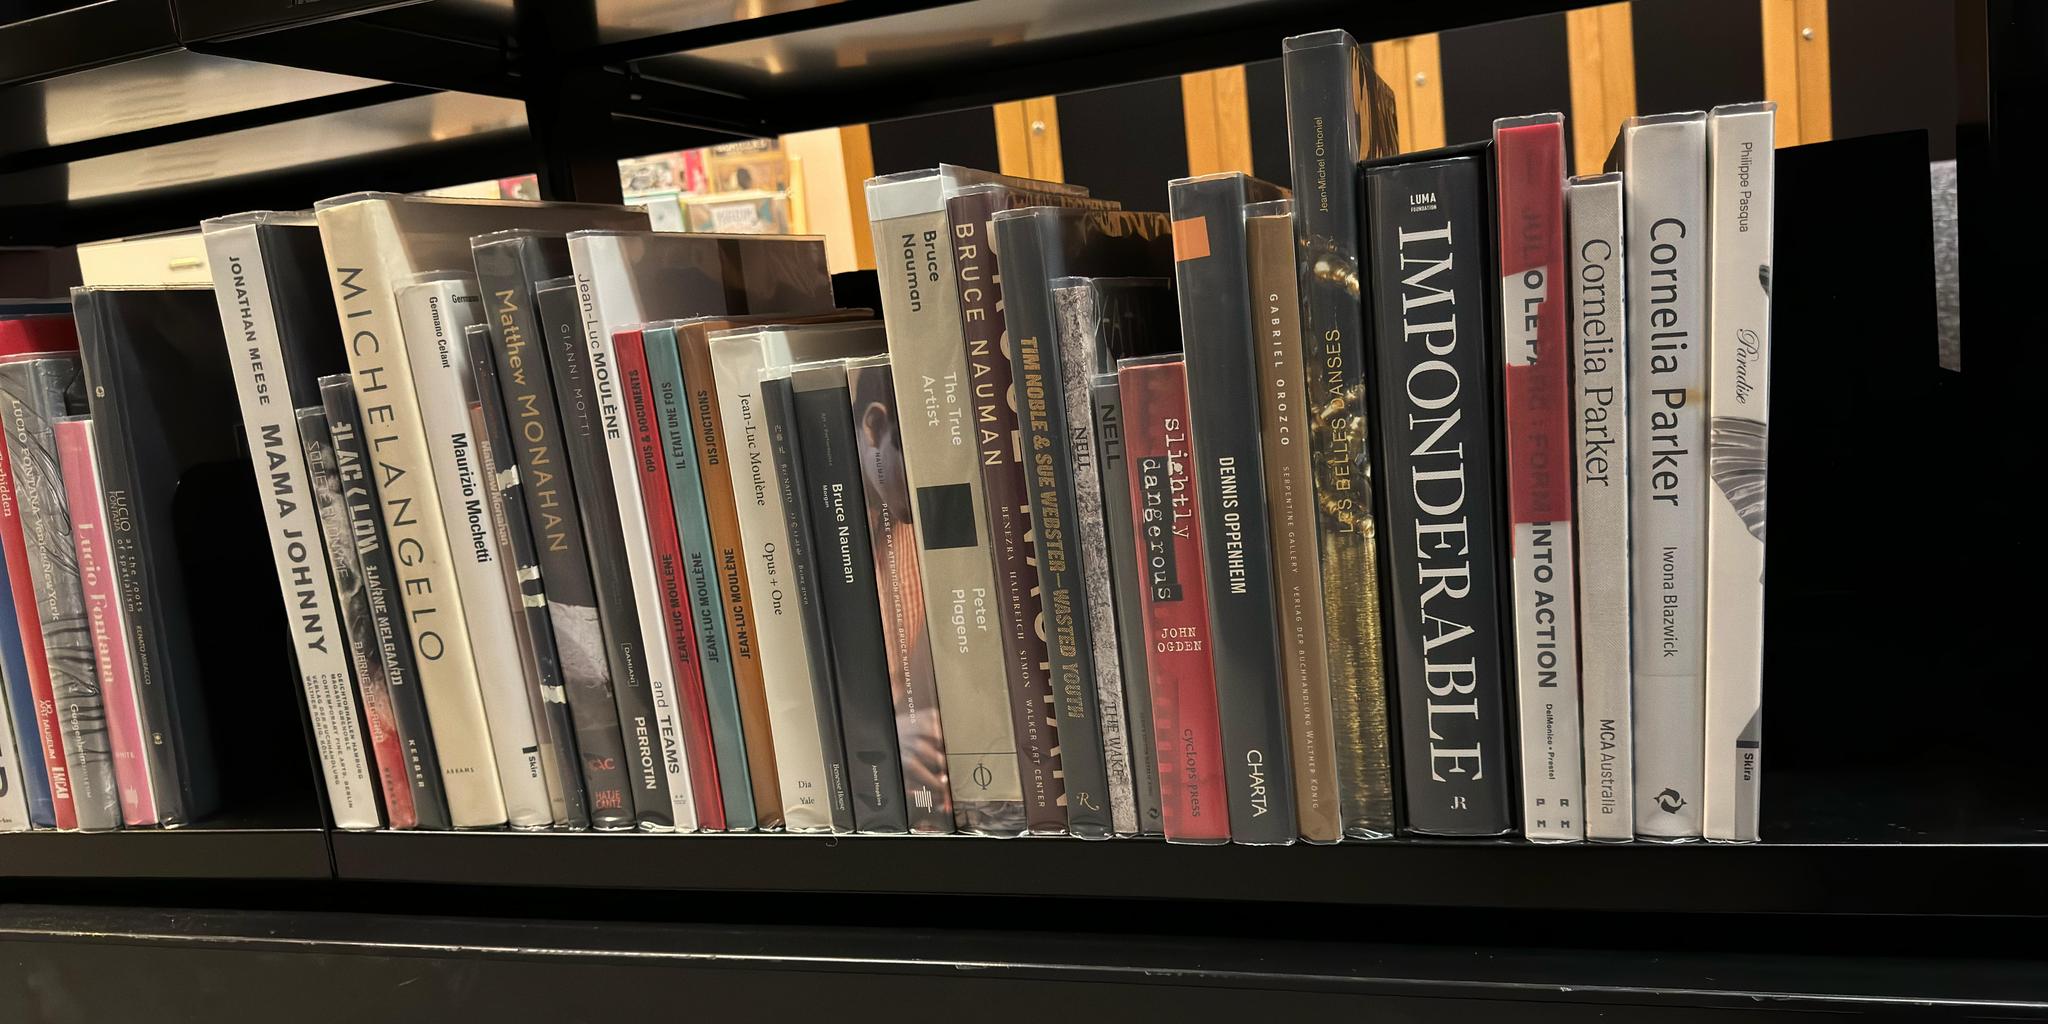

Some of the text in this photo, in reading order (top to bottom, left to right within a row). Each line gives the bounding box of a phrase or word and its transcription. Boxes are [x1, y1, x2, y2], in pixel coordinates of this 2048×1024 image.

[1311, 116, 1330, 212] Jean-Michel Othoniel
[1409, 191, 1436, 205] LUMA
[1736, 141, 1753, 232] Philippe Pasqua
[1410, 202, 1437, 213] FOUNDATION
[901, 233, 922, 312] Nauman
[923, 230, 940, 281] Bruce
[952, 223, 988, 322] BRUCE
[228, 256, 271, 405] JONATHAN MEESE
[425, 297, 453, 368] Germano Celant
[576, 273, 624, 438] Jean-Luc MOULÈNE
[1019, 336, 1041, 371] TIM
[1575, 238, 1621, 487] Cornelia Parker
[1644, 217, 1692, 507] Cornelia Parker
[559, 324, 591, 436] GIANNI MOTTI
[627, 369, 649, 431] DOCUMENTS
[921, 375, 941, 426] Artist
[968, 339, 1004, 465] NAUMAN
[1023, 374, 1049, 431] NOBLE
[1267, 293, 1290, 446] GABRIEL OROZCO
[1731, 328, 1760, 406] Paradise
[492, 289, 569, 551] Matthew MONAHAN
[660, 382, 686, 468] IL UNE FOIS
[697, 390, 719, 464] DISJONCTIONS
[942, 371, 966, 445] The True
[1031, 434, 1051, 450] &
[1100, 404, 1121, 470] NELL
[1324, 328, 1354, 532] LES BELLES DANSES
[11, 400, 41, 514] LUCIO FONTANA
[334, 268, 449, 660] MICHELANGELO
[642, 445, 656, 472] OPUS
[737, 393, 769, 505] Jean-Luc Moulène
[1034, 453, 1056, 488] SUE
[1073, 426, 1091, 471] NELL
[1160, 418, 1196, 539] slightly
[107, 490, 122, 531] FONTANA
[114, 490, 131, 531] LUCIO
[451, 433, 491, 562] Maurizio Mochetti
[480, 441, 510, 544] Matthew Monahan
[783, 477, 792, 502] NAITO
[821, 484, 829, 508] Morgan
[881, 503, 890, 532] PLEASE
[1217, 456, 1247, 594] DENNIS OPPENHEIM
[1281, 466, 1298, 573] SERPENTINE GALLERY
[1398, 220, 1485, 782] IMPONDERABLE
[1524, 298, 1557, 688] LE INTO ACTION
[259, 424, 328, 653] MAMA JOHNNY
[831, 483, 854, 583] Bruce Nauman
[1039, 491, 1067, 572] WEBSTER
[1137, 458, 1174, 600] dangerous
[76, 523, 121, 683] Lucio Fontana
[115, 538, 135, 612] of spatialism
[124, 538, 144, 612] at the roots
[689, 551, 719, 662] JEAN-LUC MOULÈNE
[721, 547, 750, 658] JEAN-LUC MOULÈNE
[760, 542, 779, 575] Opus
[770, 589, 785, 615] One
[887, 550, 898, 592] ATTENTION
[1661, 546, 1680, 657] Iwona Blazwick
[135, 625, 146, 651] RENATO
[671, 610, 690, 663] JEAN-LUC
[898, 628, 907, 653] BRUCE
[948, 589, 970, 653] Plagens
[971, 587, 989, 632] Peter
[1051, 589, 1077, 657] WASTED
[1161, 625, 1196, 640] JOHN
[352, 641, 371, 683] BJARNE
[377, 616, 404, 685] MELGAARD
[901, 656, 913, 694] NAUMAN'S
[1000, 506, 1045, 807] BENEZRA HALBREICH SIMON WALKER ART CENTER
[1157, 638, 1202, 654] OGDEN
[1292, 585, 1317, 775] VERLAG DER BUCHHANDLUNG WALTHER
[329, 673, 351, 751] MAGASIN GRENOBLE
[335, 673, 363, 779] DEICHTORHALLEN HAMBURG
[653, 681, 668, 707] and
[907, 697, 917, 724] WORDS
[1061, 662, 1084, 718] YOUTH
[42, 720, 55, 759] MUSEUM
[67, 703, 88, 764] Guggenheim
[311, 675, 340, 784] VERLAG DER BUCHHANDLUNG
[319, 674, 354, 807] CONTEMPORARY FINE BERLIN
[407, 740, 425, 786] KERBER
[631, 717, 659, 789] PERROTIN
[658, 715, 681, 773] TEAMS
[1104, 701, 1124, 777] THE WAKE
[1544, 703, 1556, 779] DelMonico Prestel
[528, 756, 538, 778] Skira
[596, 790, 622, 800] HATJE
[798, 780, 812, 788] Dia
[799, 796, 815, 805] Yale
[831, 763, 846, 810] Benesse House
[871, 764, 881, 806] Johns Hopkins
[1244, 749, 1269, 818] CHARTA
[1599, 719, 1617, 814] MCA Australia
[1743, 752, 1753, 781] Skira
[596, 798, 622, 809] CANTZ
